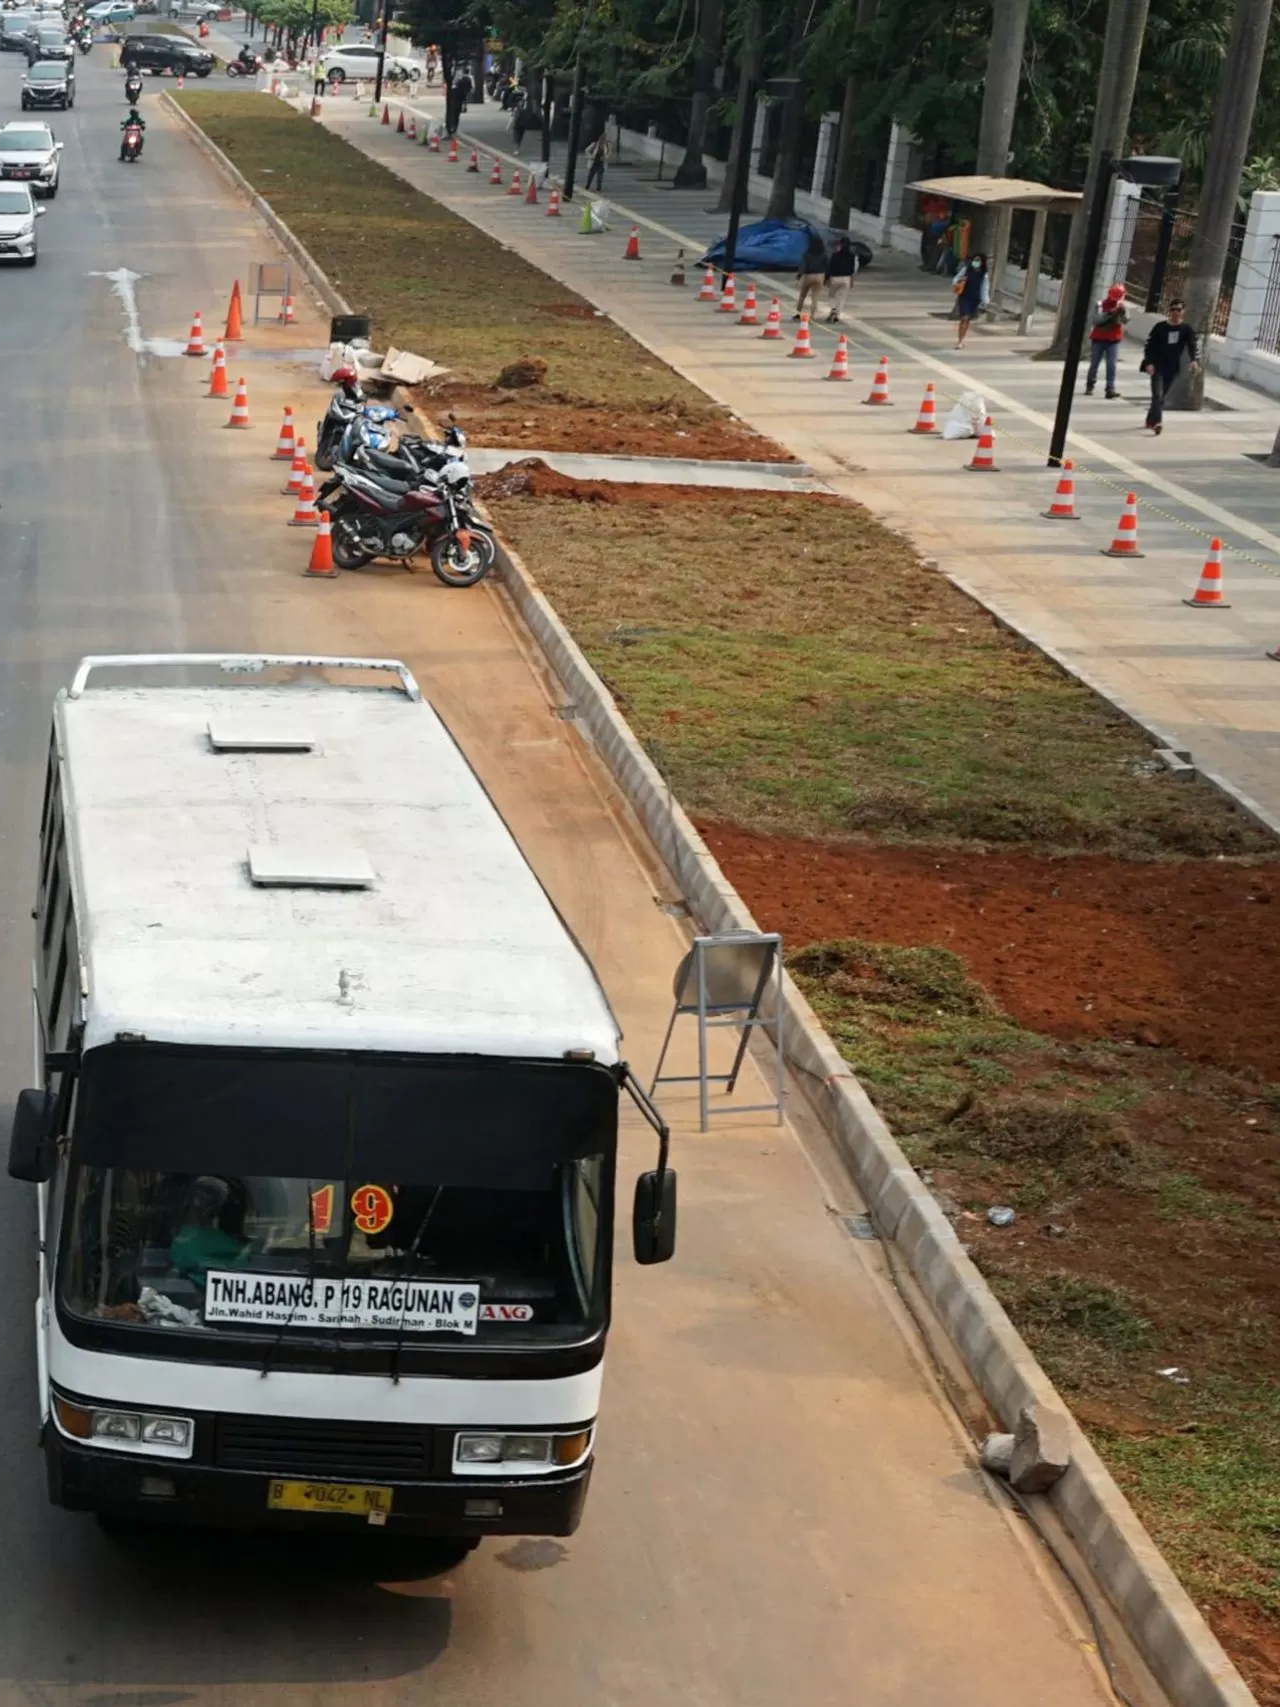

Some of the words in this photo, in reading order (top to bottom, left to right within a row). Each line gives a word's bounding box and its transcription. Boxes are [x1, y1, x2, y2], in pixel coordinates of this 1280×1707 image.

[324, 1285, 335, 1309] P
[343, 1285, 362, 1309] 19
[368, 1286, 454, 1314] RAGUNAN
[318, 1313, 361, 1324] Sarinah
[372, 1315, 425, 1327] Sudirman
[435, 1318, 459, 1328] Blok
[464, 1320, 473, 1329] M
[274, 1484, 284, 1499] B
